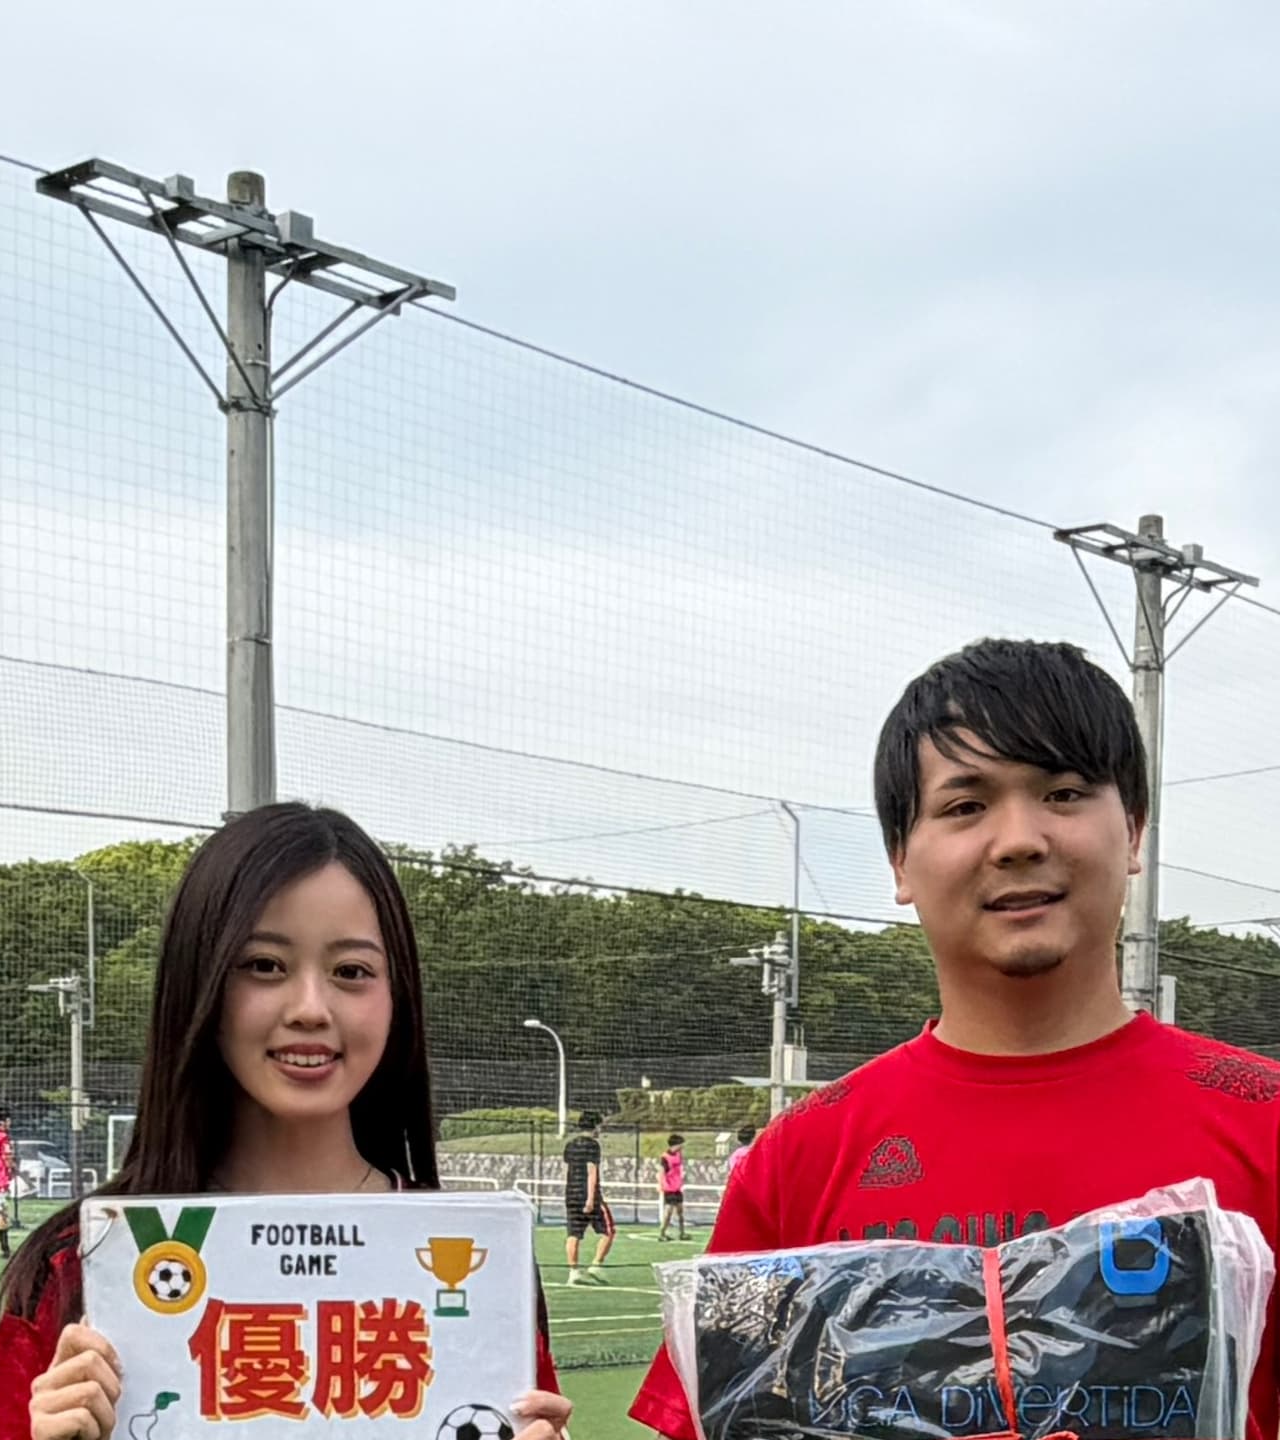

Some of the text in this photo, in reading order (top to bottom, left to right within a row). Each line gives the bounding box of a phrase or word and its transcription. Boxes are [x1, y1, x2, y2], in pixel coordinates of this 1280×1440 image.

[251, 1224, 365, 1247] FOOTBALL
[279, 1254, 338, 1276] GAME
[188, 1297, 434, 1421] 優勝
